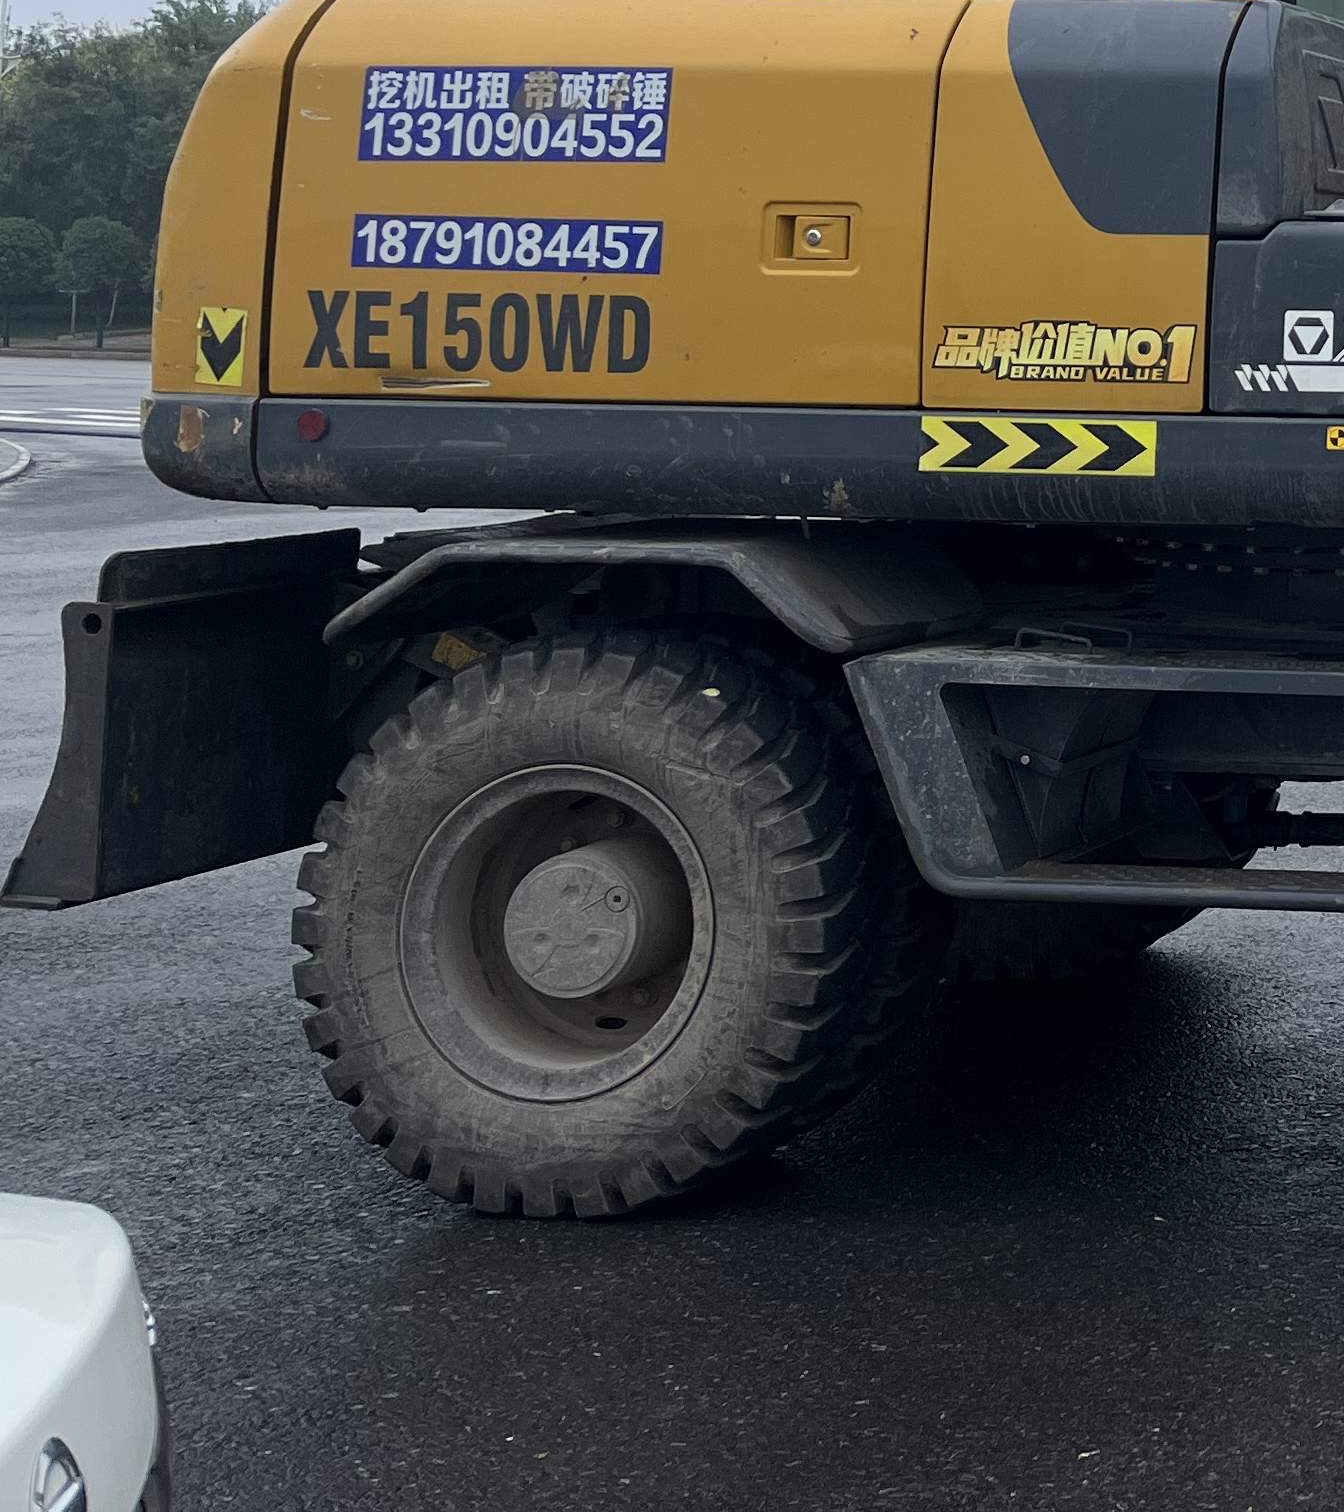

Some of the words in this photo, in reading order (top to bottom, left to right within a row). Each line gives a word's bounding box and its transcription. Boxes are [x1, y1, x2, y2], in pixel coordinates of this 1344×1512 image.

[367, 70, 510, 110] 挖机出租
[523, 70, 668, 111] 带破碎锤
[364, 111, 664, 159] 13310904552
[356, 219, 661, 270] 18791084457
[302, 289, 652, 375] XE150WD
[1009, 365, 1085, 380] BRAND
[1094, 367, 1166, 381] VALUE
